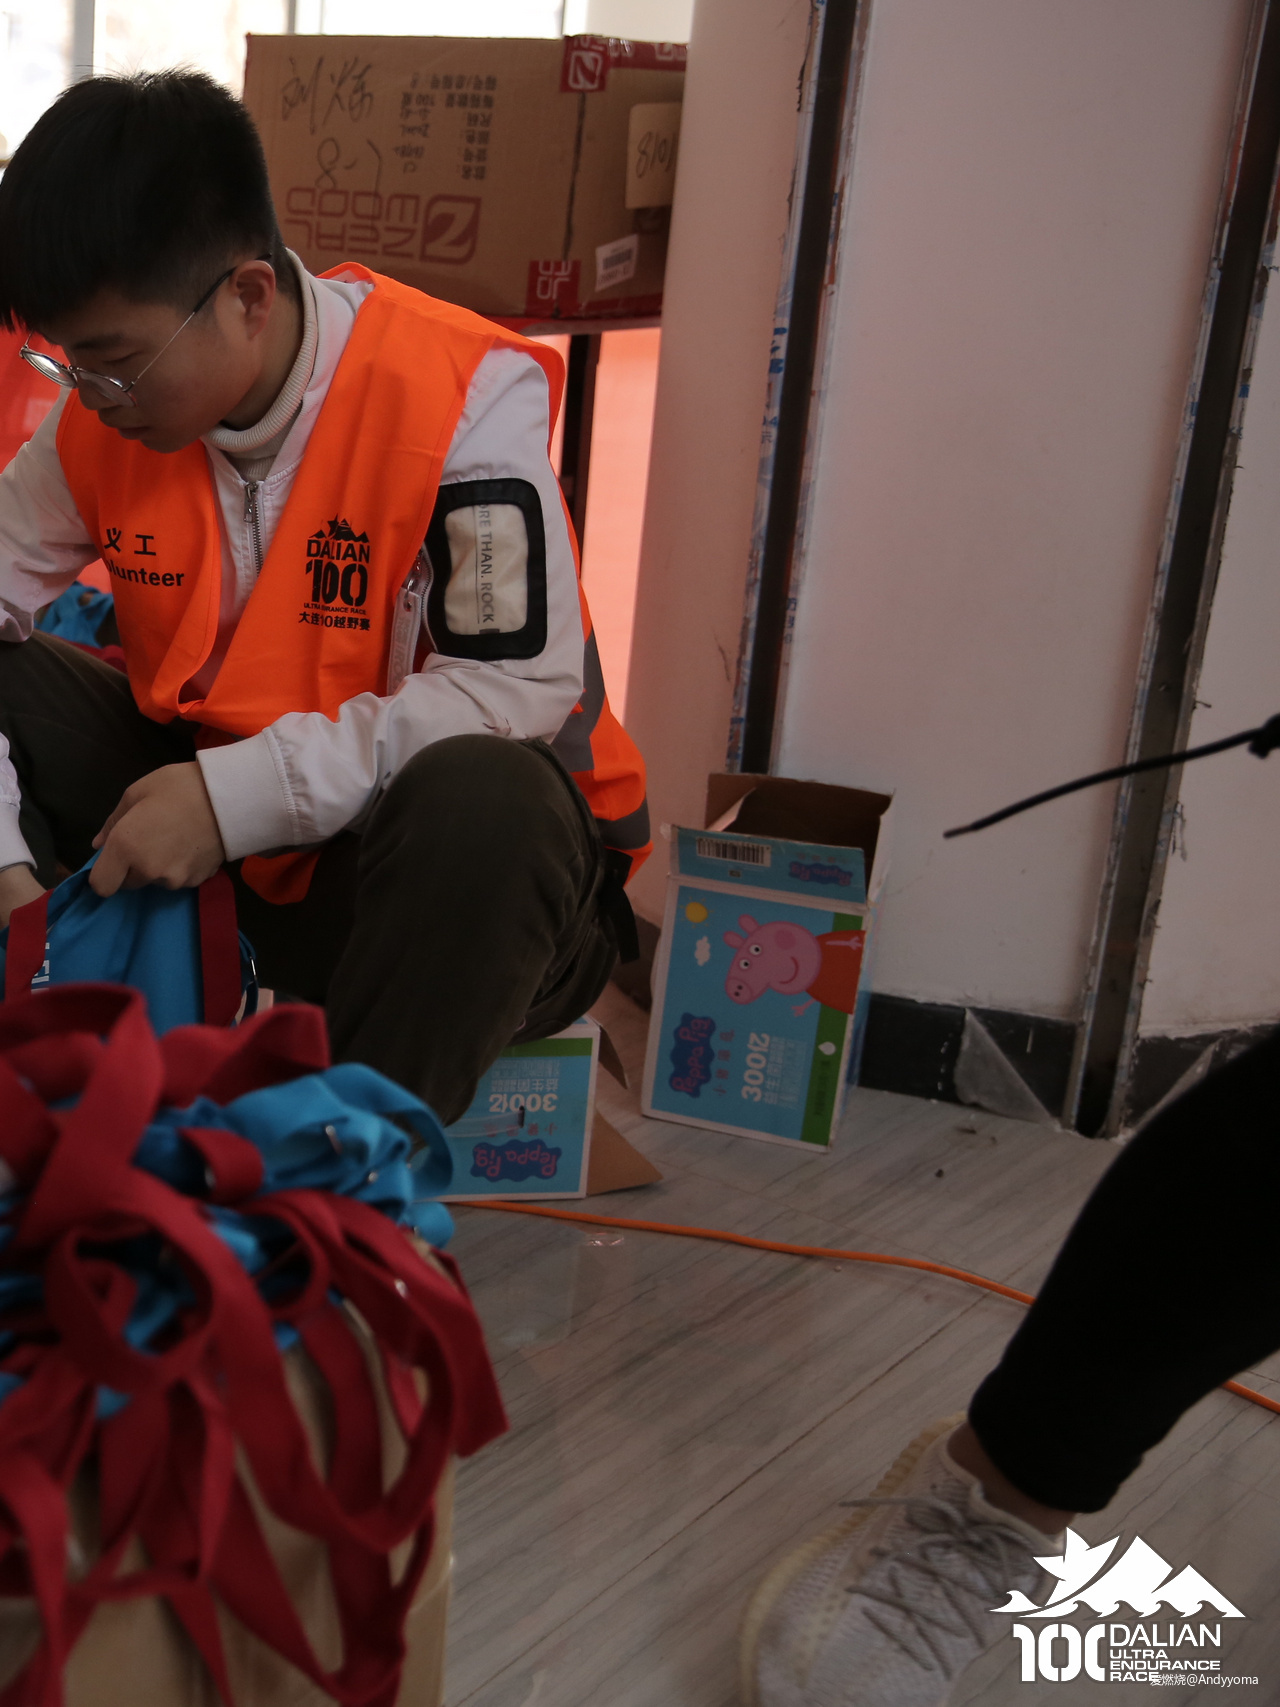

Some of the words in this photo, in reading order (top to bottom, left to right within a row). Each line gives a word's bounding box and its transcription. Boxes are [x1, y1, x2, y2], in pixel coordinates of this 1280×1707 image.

[285, 187, 419, 224] WOOD
[283, 218, 417, 259] ZEAL
[103, 527, 157, 556] 义工
[306, 539, 371, 564] DALIAN
[305, 558, 369, 607] 100
[480, 583, 495, 624] ROCK
[677, 1016, 712, 1043] Pig
[670, 1045, 707, 1094] Peppa
[740, 1031, 771, 1102] 300亿
[488, 1092, 559, 1113] 300亿
[473, 1146, 502, 1178] Pig
[504, 1144, 558, 1177] Peppa
